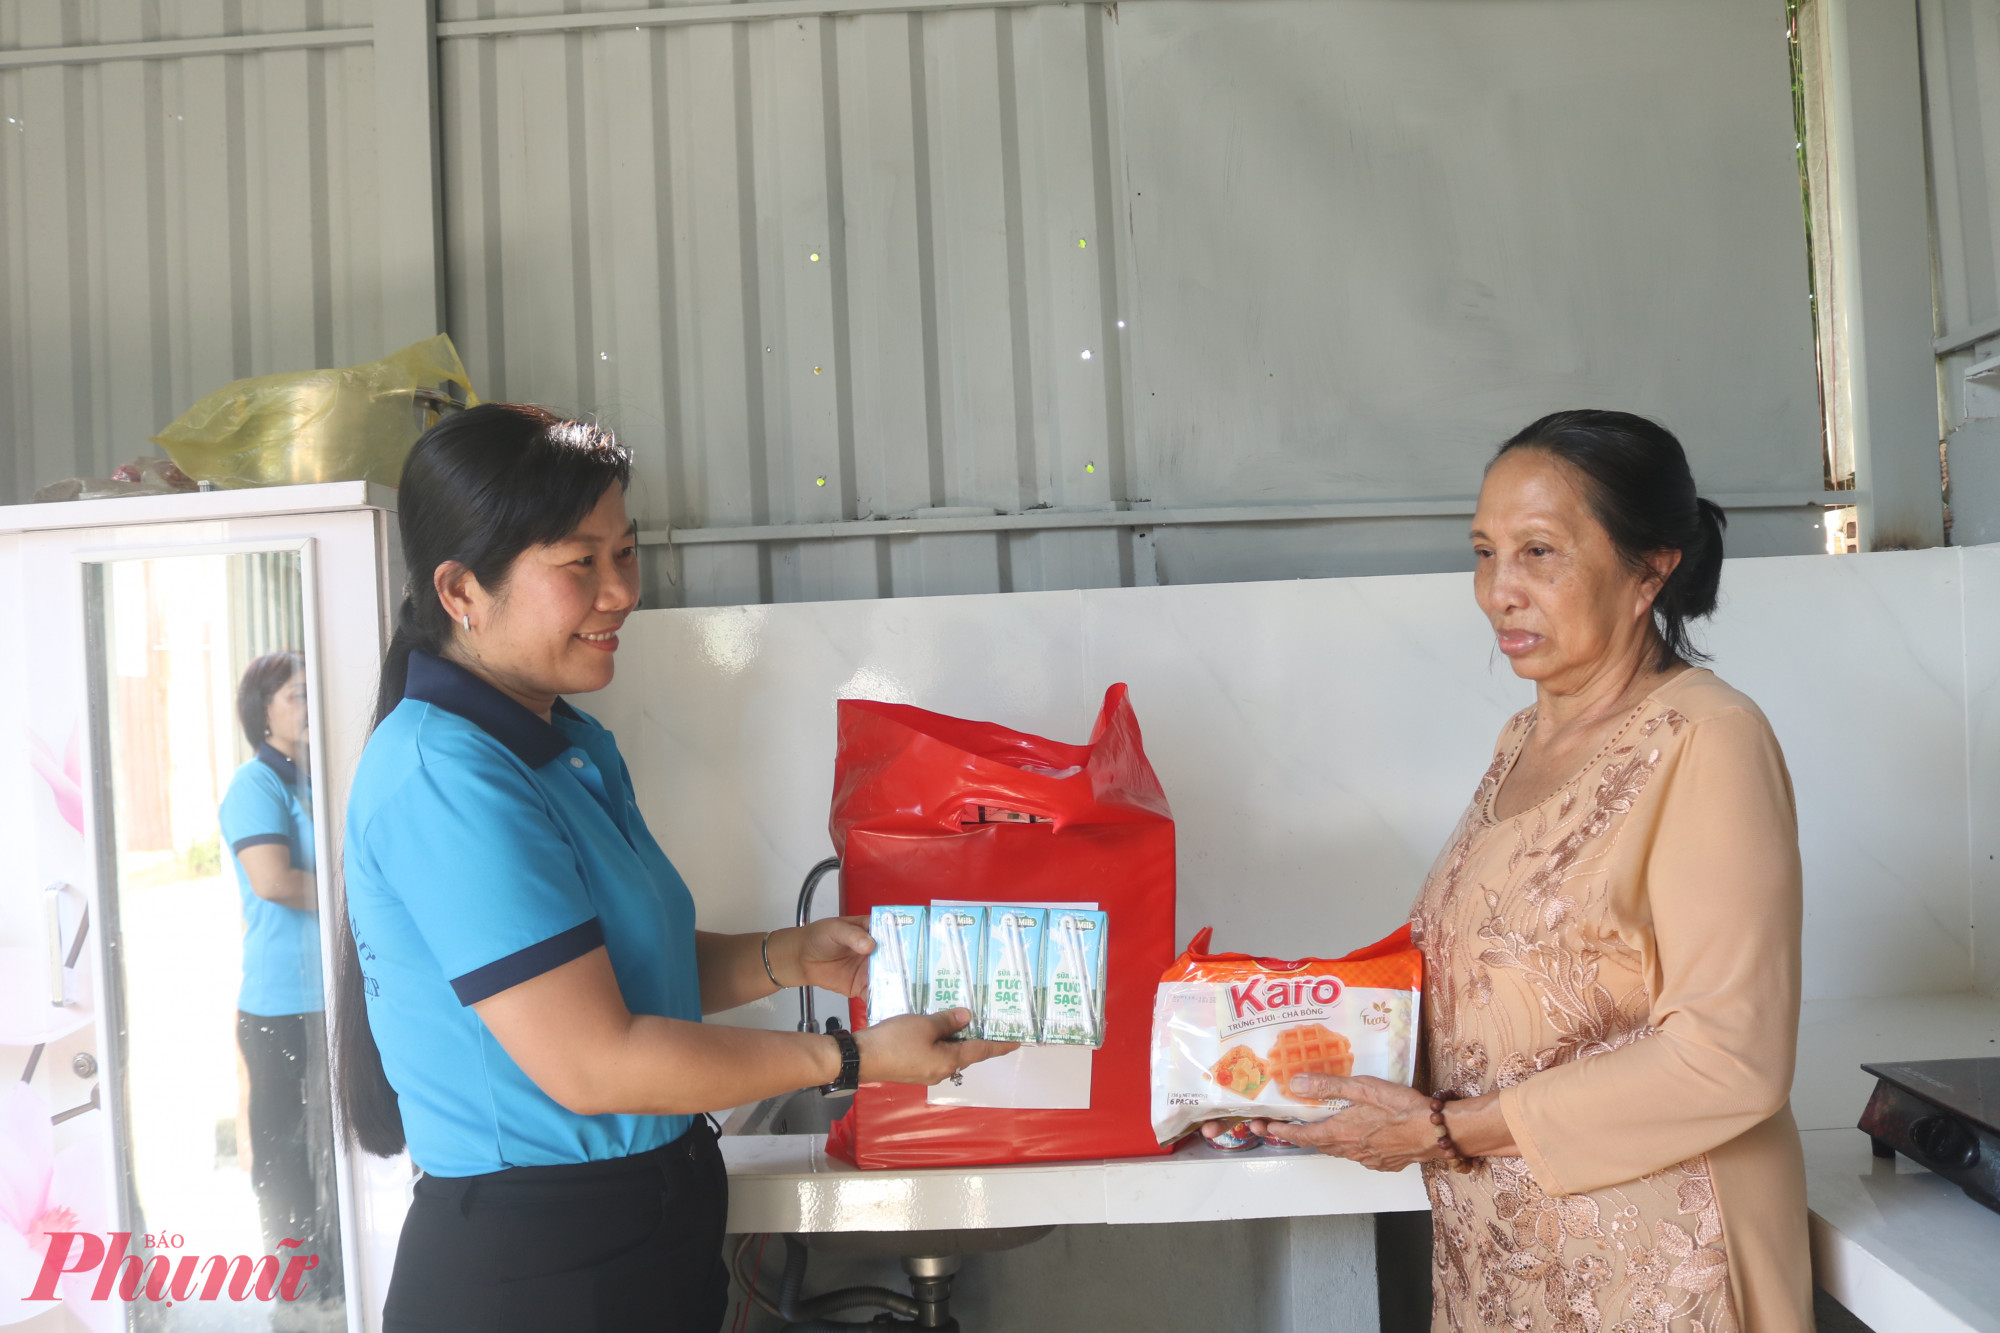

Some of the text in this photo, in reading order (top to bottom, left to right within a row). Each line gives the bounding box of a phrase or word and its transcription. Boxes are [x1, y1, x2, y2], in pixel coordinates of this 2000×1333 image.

[1018, 917, 1035, 927] Milk
[1077, 920, 1094, 930] Milk
[1229, 977, 1342, 1019] Karo
[1256, 1013, 1276, 1024] TƯƠI
[1300, 1007, 1324, 1017] BÔNG
